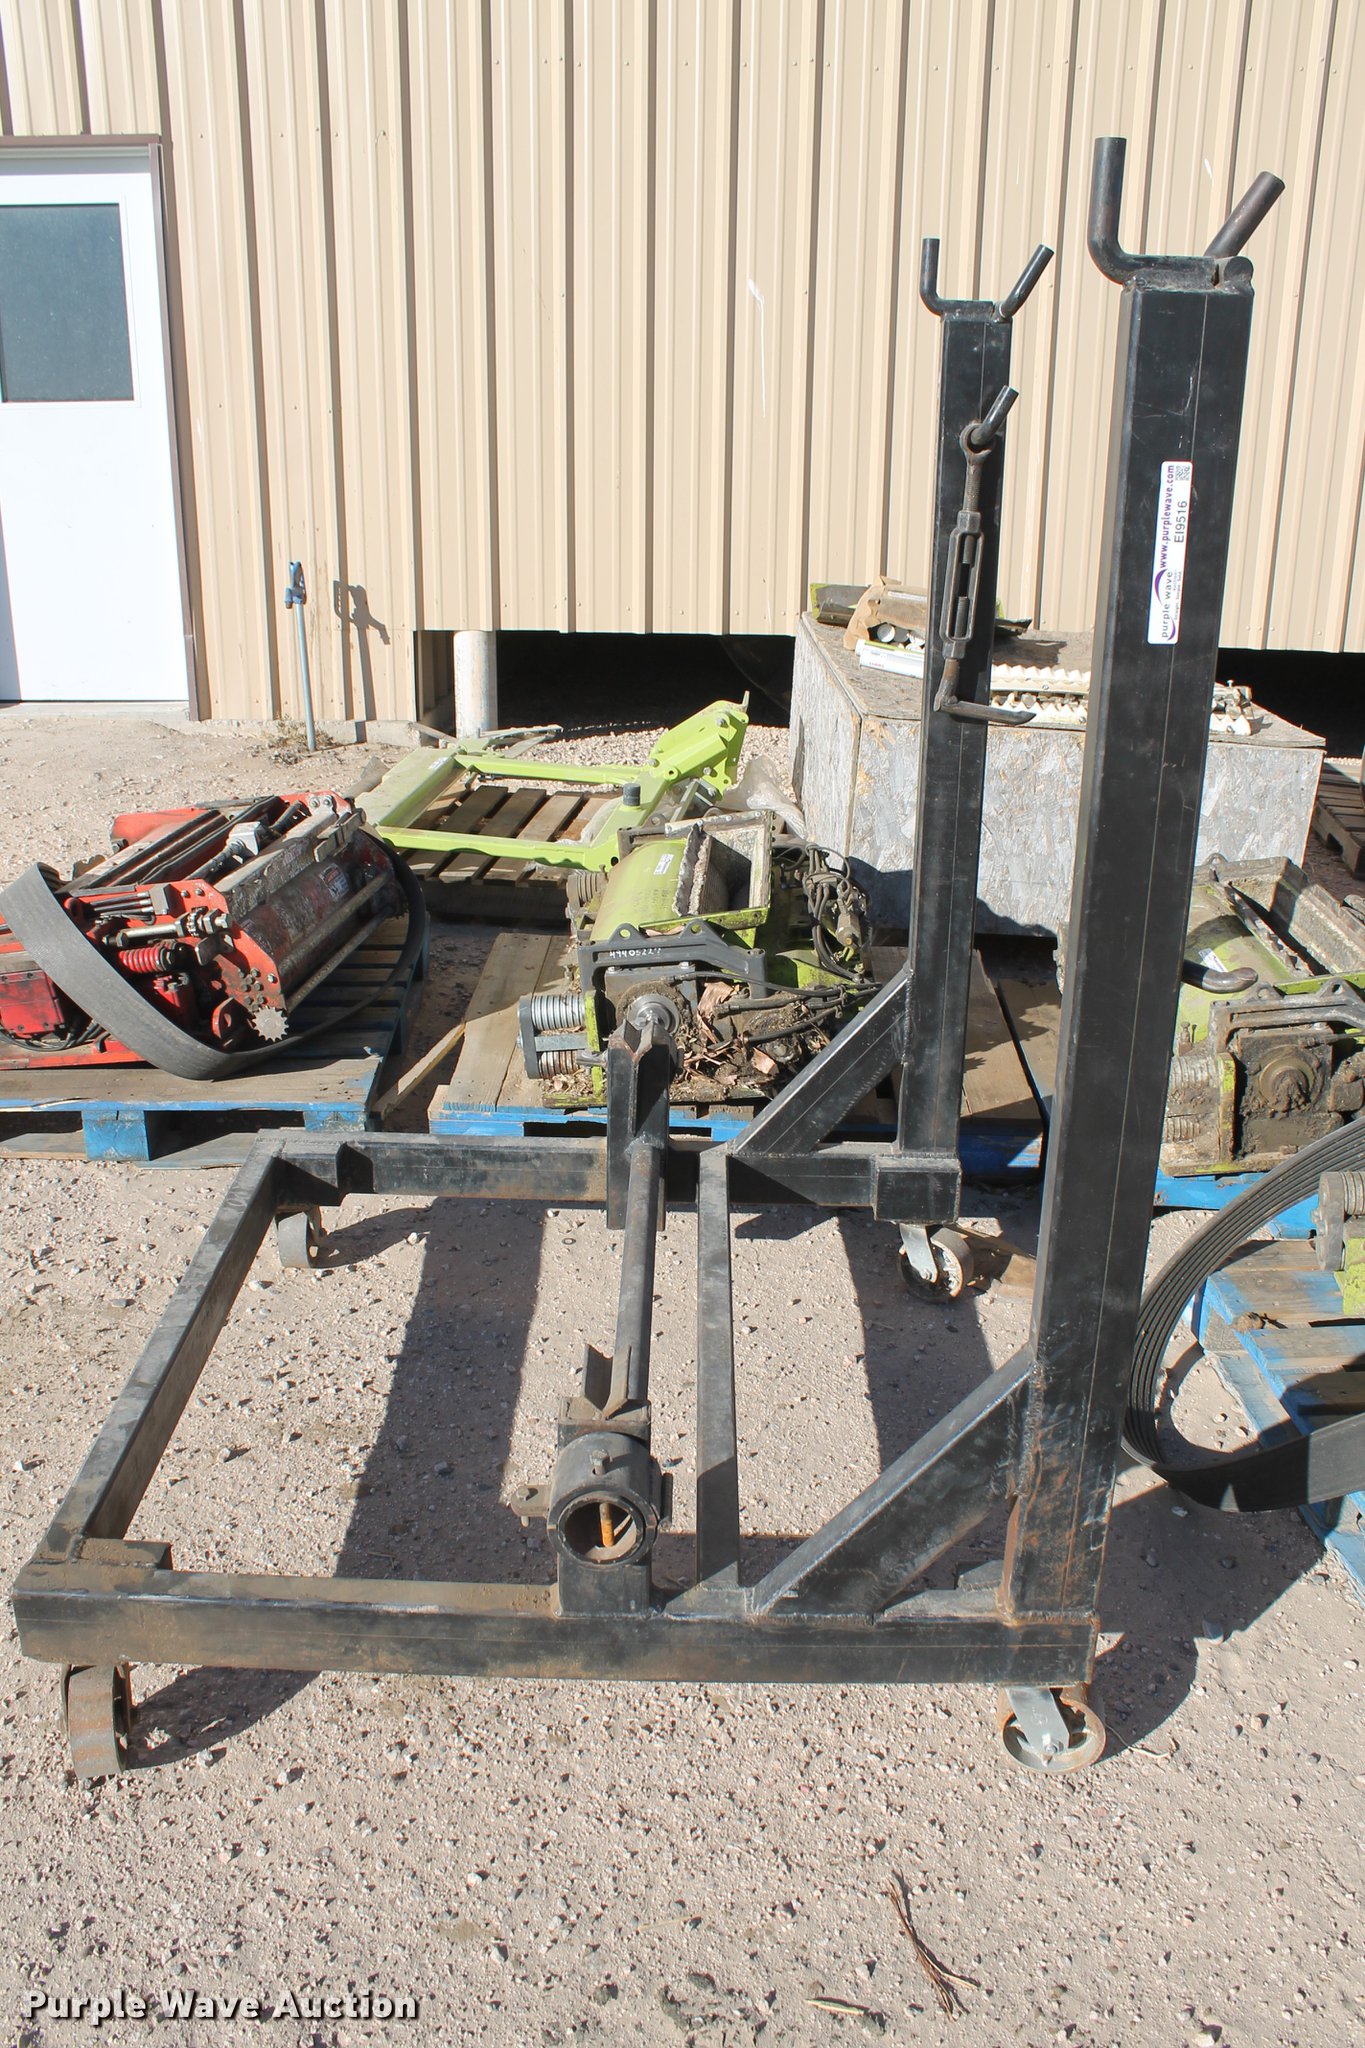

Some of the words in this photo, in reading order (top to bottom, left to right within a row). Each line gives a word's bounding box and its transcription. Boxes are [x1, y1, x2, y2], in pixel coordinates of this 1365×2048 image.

[1160, 465, 1175, 569] www.purplewave.com
[1174, 500, 1188, 543] EI9516
[1165, 571, 1173, 602] wave
[1161, 604, 1171, 638] purple
